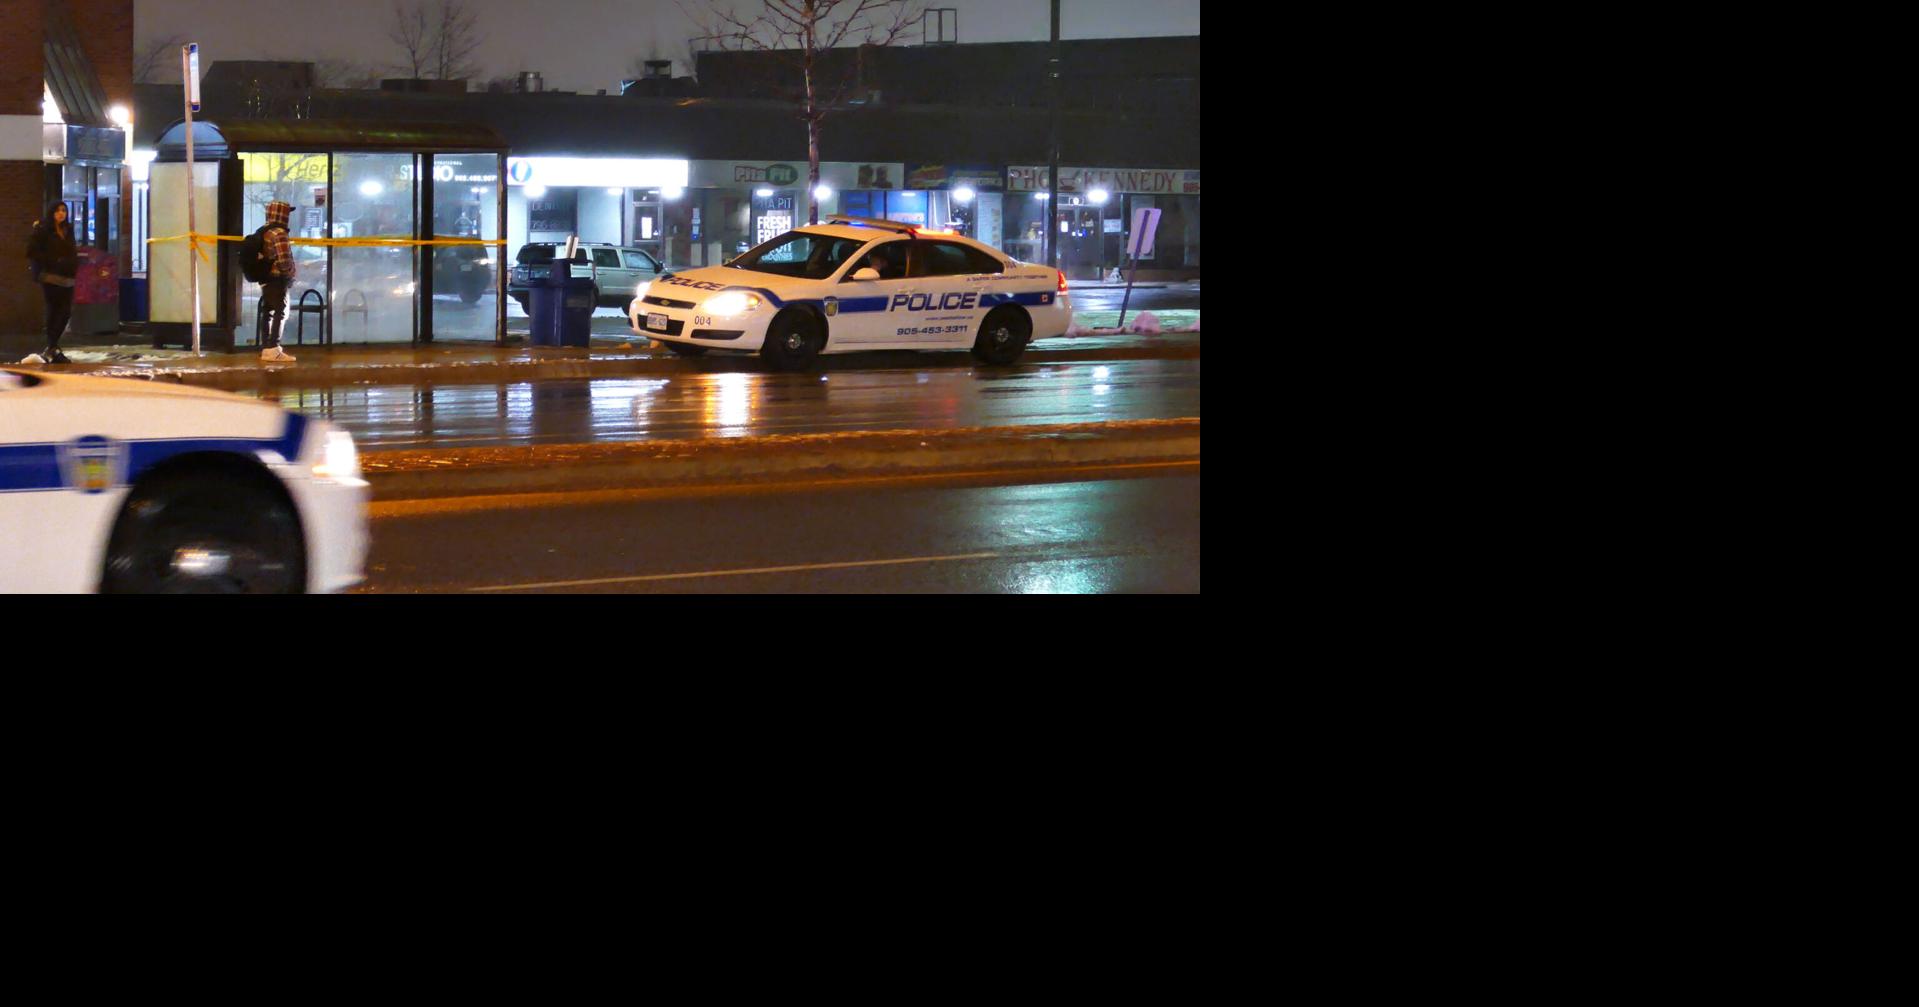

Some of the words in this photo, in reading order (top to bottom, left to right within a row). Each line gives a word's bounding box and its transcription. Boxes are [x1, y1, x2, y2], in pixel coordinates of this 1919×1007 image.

[757, 215, 791, 230] FRESH
[667, 276, 726, 291] POLICE
[890, 292, 977, 312] POLICE
[694, 315, 711, 326] 004
[897, 325, 968, 336] 905-453-3311
